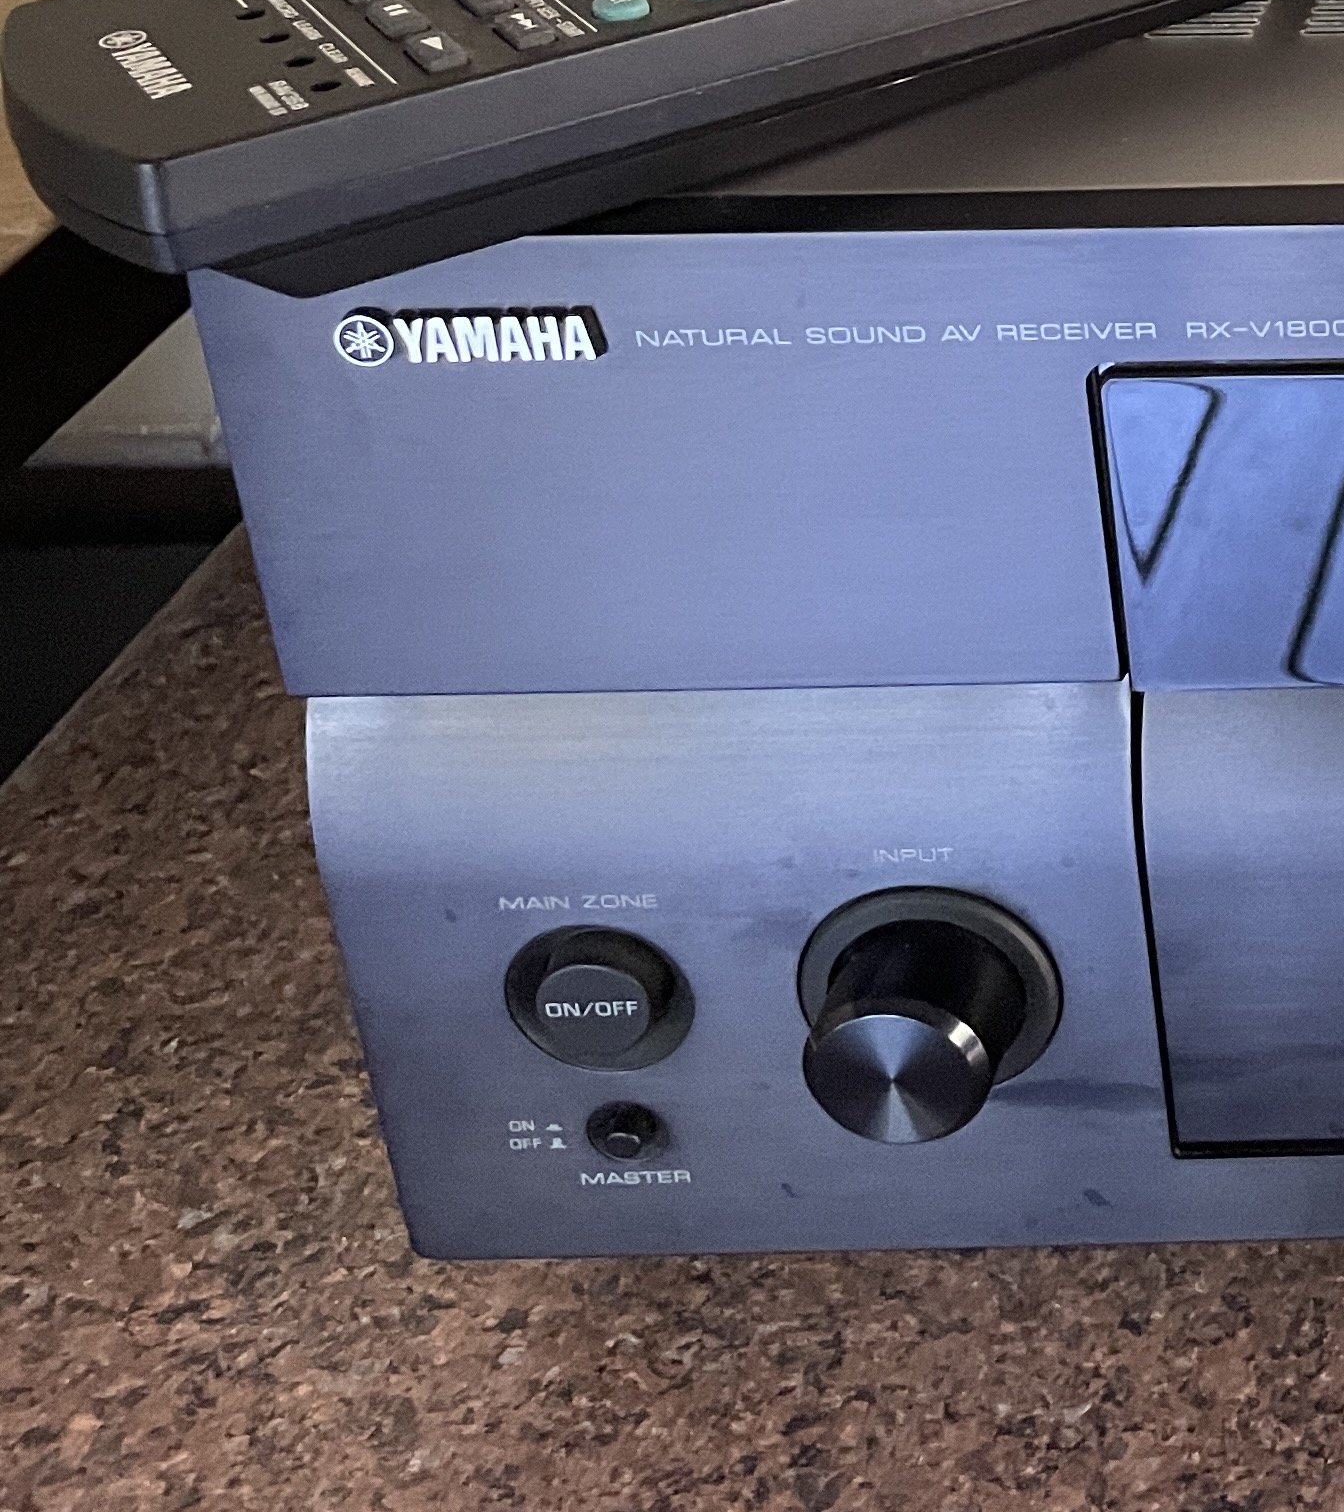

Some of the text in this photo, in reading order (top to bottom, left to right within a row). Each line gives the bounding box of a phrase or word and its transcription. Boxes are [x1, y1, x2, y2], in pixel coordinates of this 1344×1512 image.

[318, 43, 348, 63] CLEAR
[111, 42, 193, 99] YAMAHA
[393, 315, 597, 363] YAMAHA
[635, 329, 792, 348] NATURAL
[805, 326, 926, 345] SOUND
[941, 324, 982, 342] AV
[996, 322, 1157, 341] RECEIVER
[873, 847, 954, 863] INPUT
[500, 894, 657, 911] MAIN ZONE
[545, 1000, 638, 1018] ON/OFF
[509, 1120, 535, 1133] ON
[509, 1138, 541, 1150] OFF
[581, 1170, 691, 1186] MASTER
